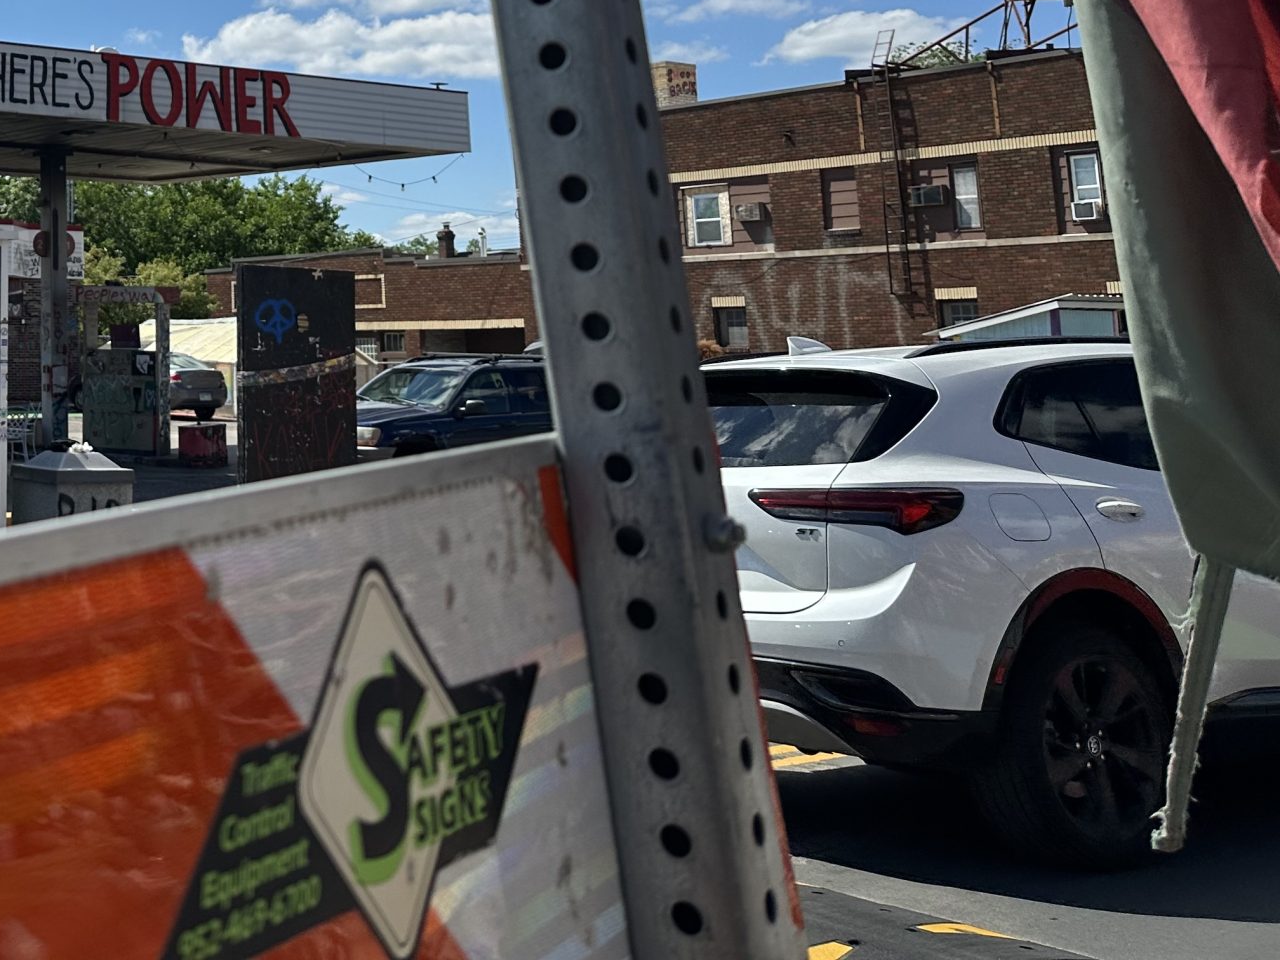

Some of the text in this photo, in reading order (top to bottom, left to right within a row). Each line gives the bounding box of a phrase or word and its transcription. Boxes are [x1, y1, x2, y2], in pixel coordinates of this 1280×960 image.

[101, 52, 302, 137] POWER
[220, 794, 295, 852] Control
[414, 769, 491, 848] SIGNS
